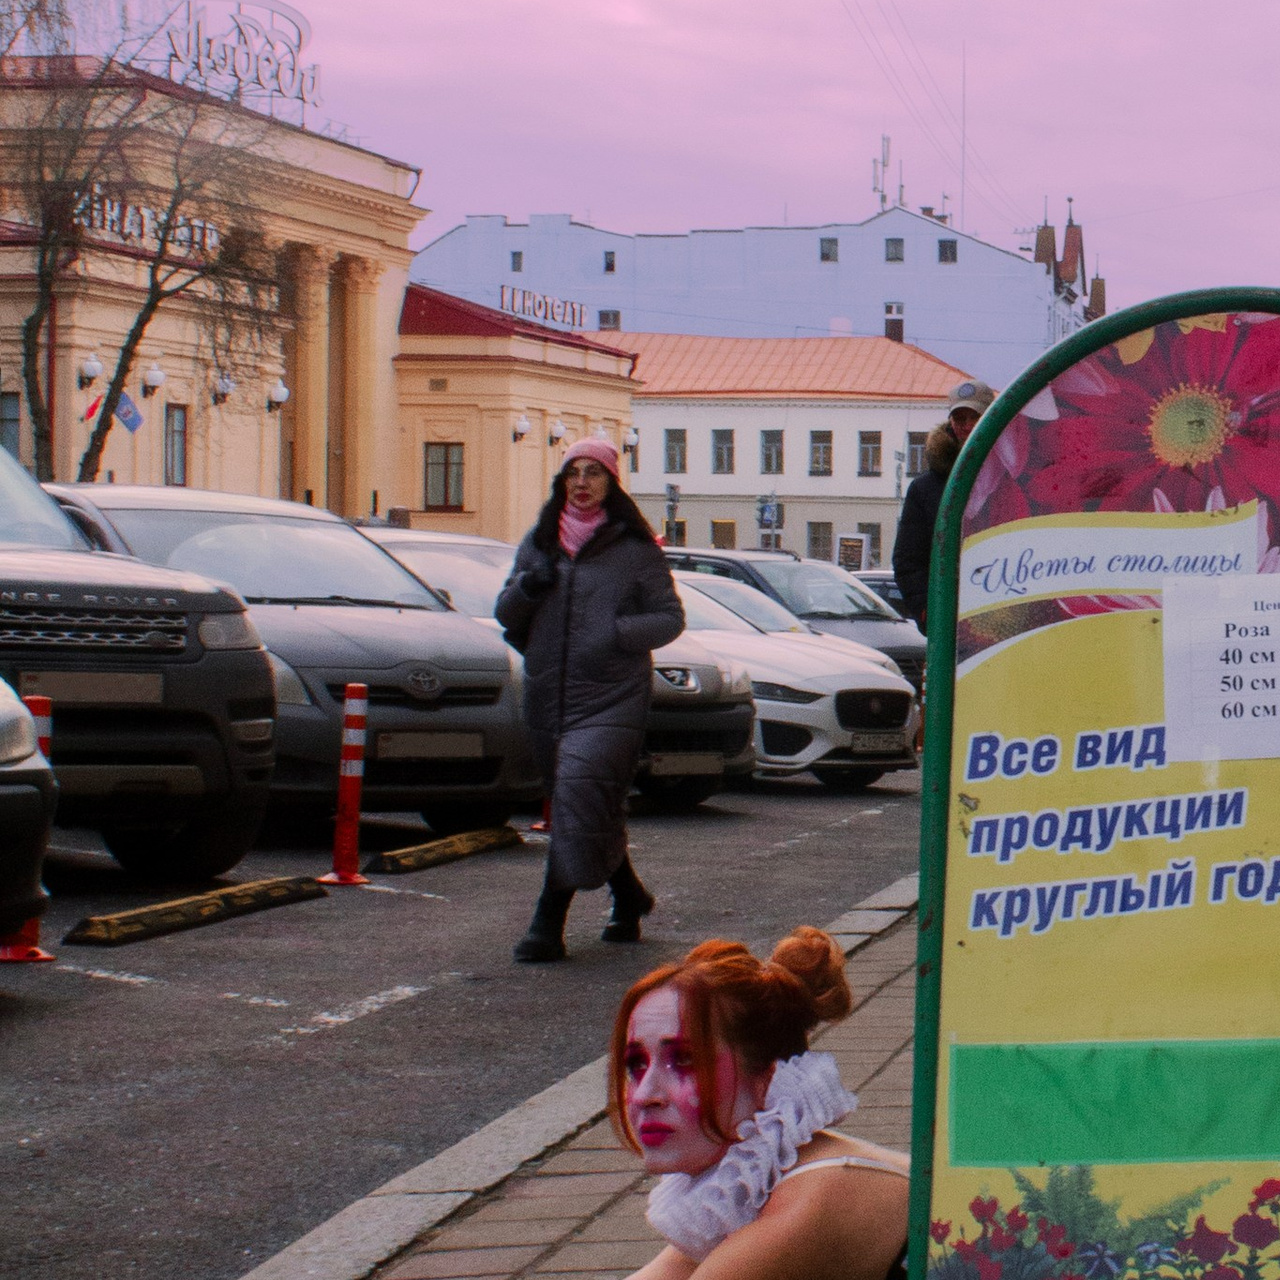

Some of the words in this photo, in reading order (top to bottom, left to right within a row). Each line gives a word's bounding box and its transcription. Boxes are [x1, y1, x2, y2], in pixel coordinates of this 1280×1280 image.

[969, 547, 1096, 596] Цветы
[1106, 552, 1243, 577] столицы
[83, 594, 179, 607] ROVER
[1224, 622, 1271, 639] Роза
[1219, 648, 1243, 665] 40
[1249, 651, 1275, 664] см
[1220, 674, 1244, 693] 50
[1250, 677, 1276, 691] см
[1221, 701, 1244, 719] 60
[1251, 704, 1277, 718] см
[965, 734, 1059, 780] Все
[969, 790, 1246, 862] продукции
[970, 860, 1194, 936] круглый
